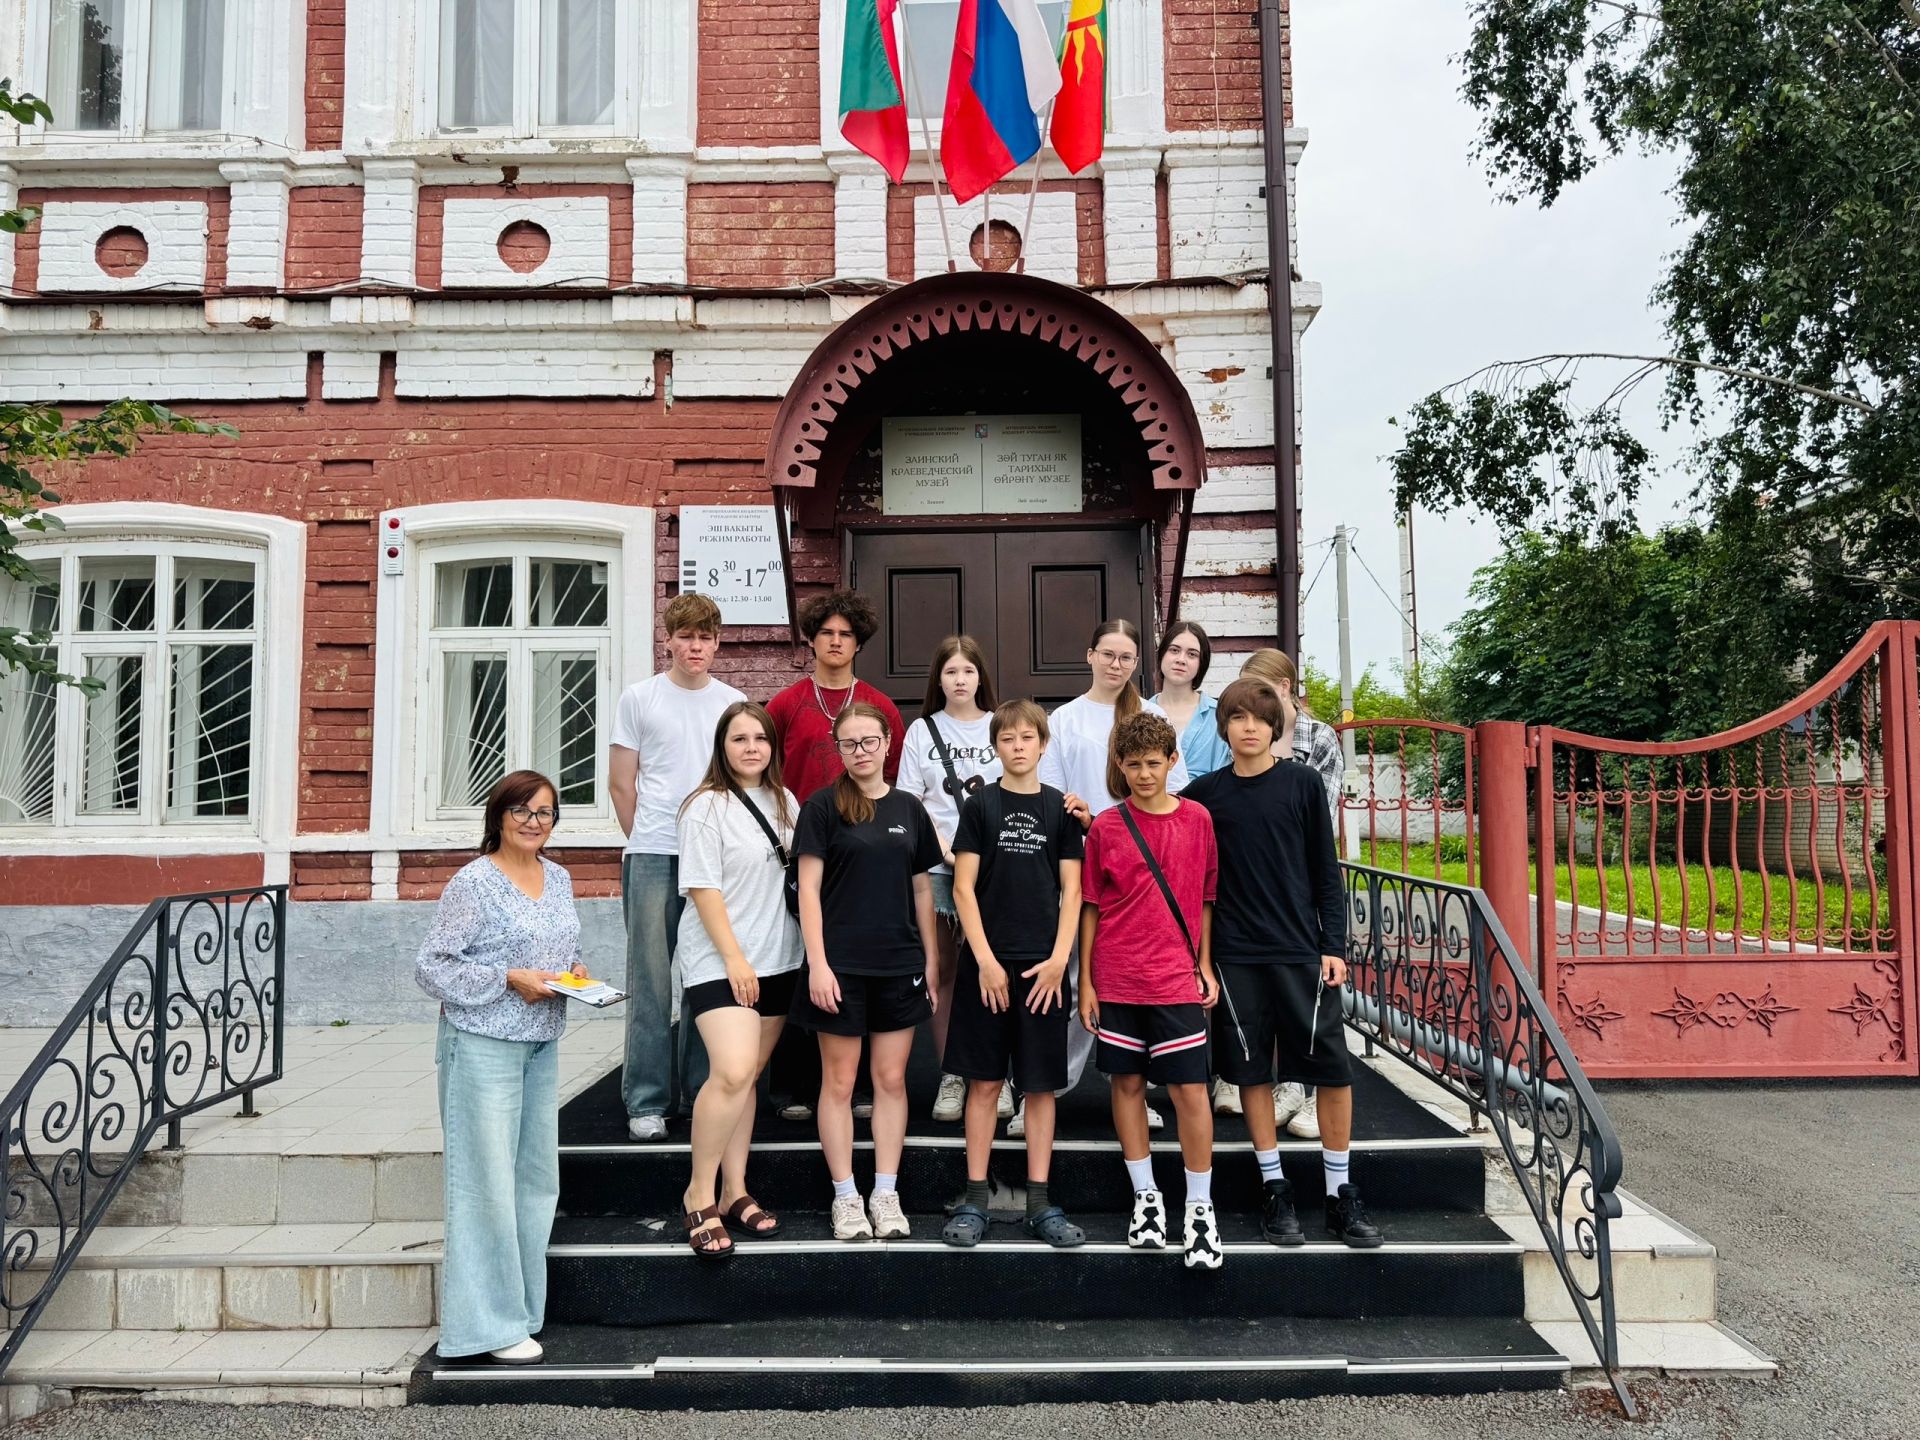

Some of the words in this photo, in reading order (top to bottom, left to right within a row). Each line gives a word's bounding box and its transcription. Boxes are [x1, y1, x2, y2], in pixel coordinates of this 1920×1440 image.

[905, 453, 959, 464] ЗАИНСКИЙ
[997, 452, 1018, 462] ЗӘЙ
[1022, 454, 1052, 462] ТУГАН
[1054, 453, 1068, 461] ЯК
[891, 465, 974, 476] КРАЕВЕДЧЕСКИЙ
[1008, 464, 1056, 473] ТАРИХЫН
[915, 477, 949, 487] МУЗЕЙ
[1038, 474, 1072, 483] МУЗЕЕ
[928, 742, 997, 764] Cherry
